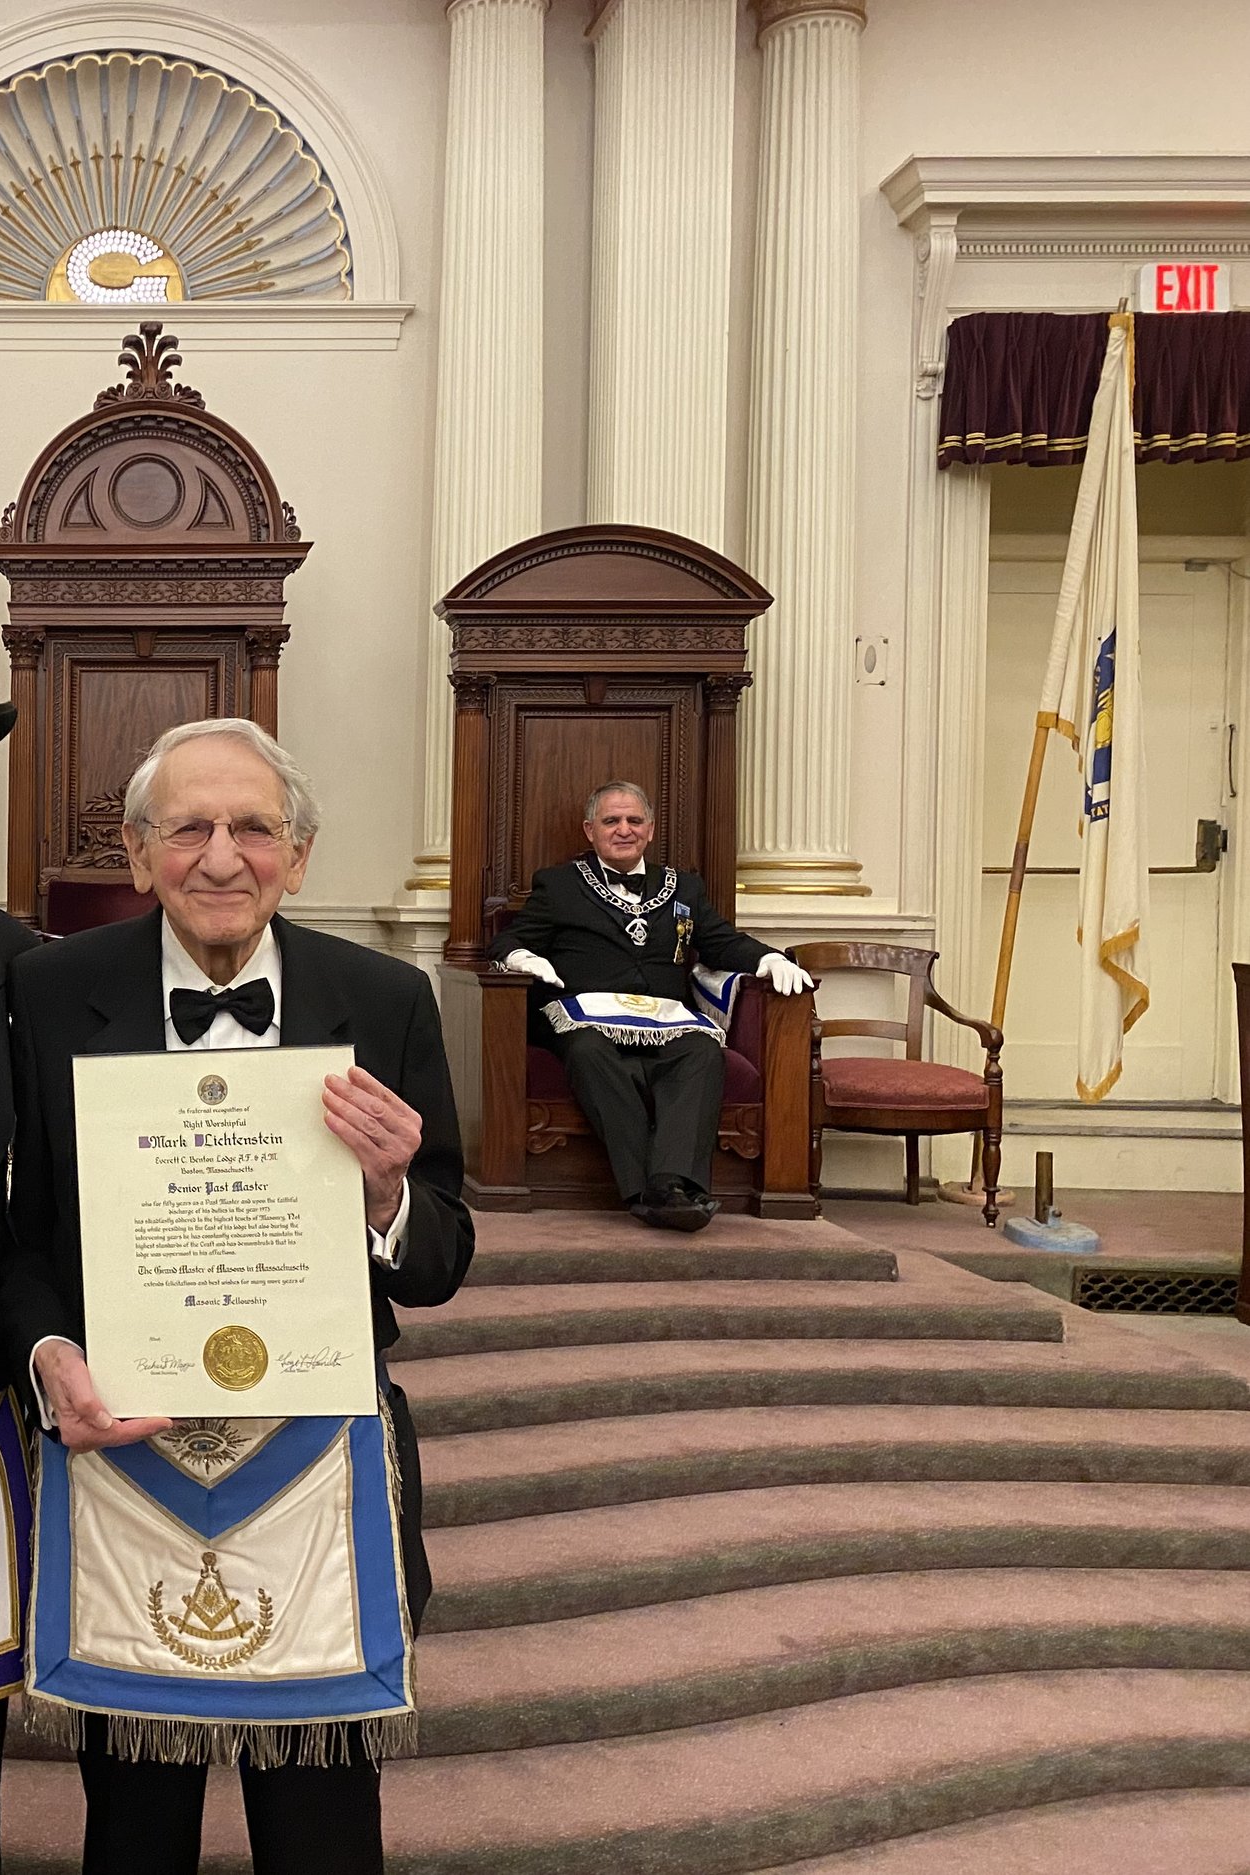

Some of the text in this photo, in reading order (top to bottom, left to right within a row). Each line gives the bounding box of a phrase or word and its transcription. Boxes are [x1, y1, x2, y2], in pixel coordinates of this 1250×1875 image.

[67, 230, 168, 303] G
[1156, 265, 1219, 311] EXIT
[183, 1118, 246, 1130] Right Worshipful
[149, 1132, 283, 1148] Mark Lichtenstein
[217, 1155, 236, 1164] Lodge
[168, 1181, 268, 1195] Senior Past Master
[138, 1266, 152, 1275] The
[154, 1266, 177, 1275] Grand
[179, 1265, 204, 1274] Master
[217, 1264, 245, 1273] Masons
[256, 1263, 309, 1272] Massachusetts
[185, 1295, 267, 1307] Masonic Fellowship
